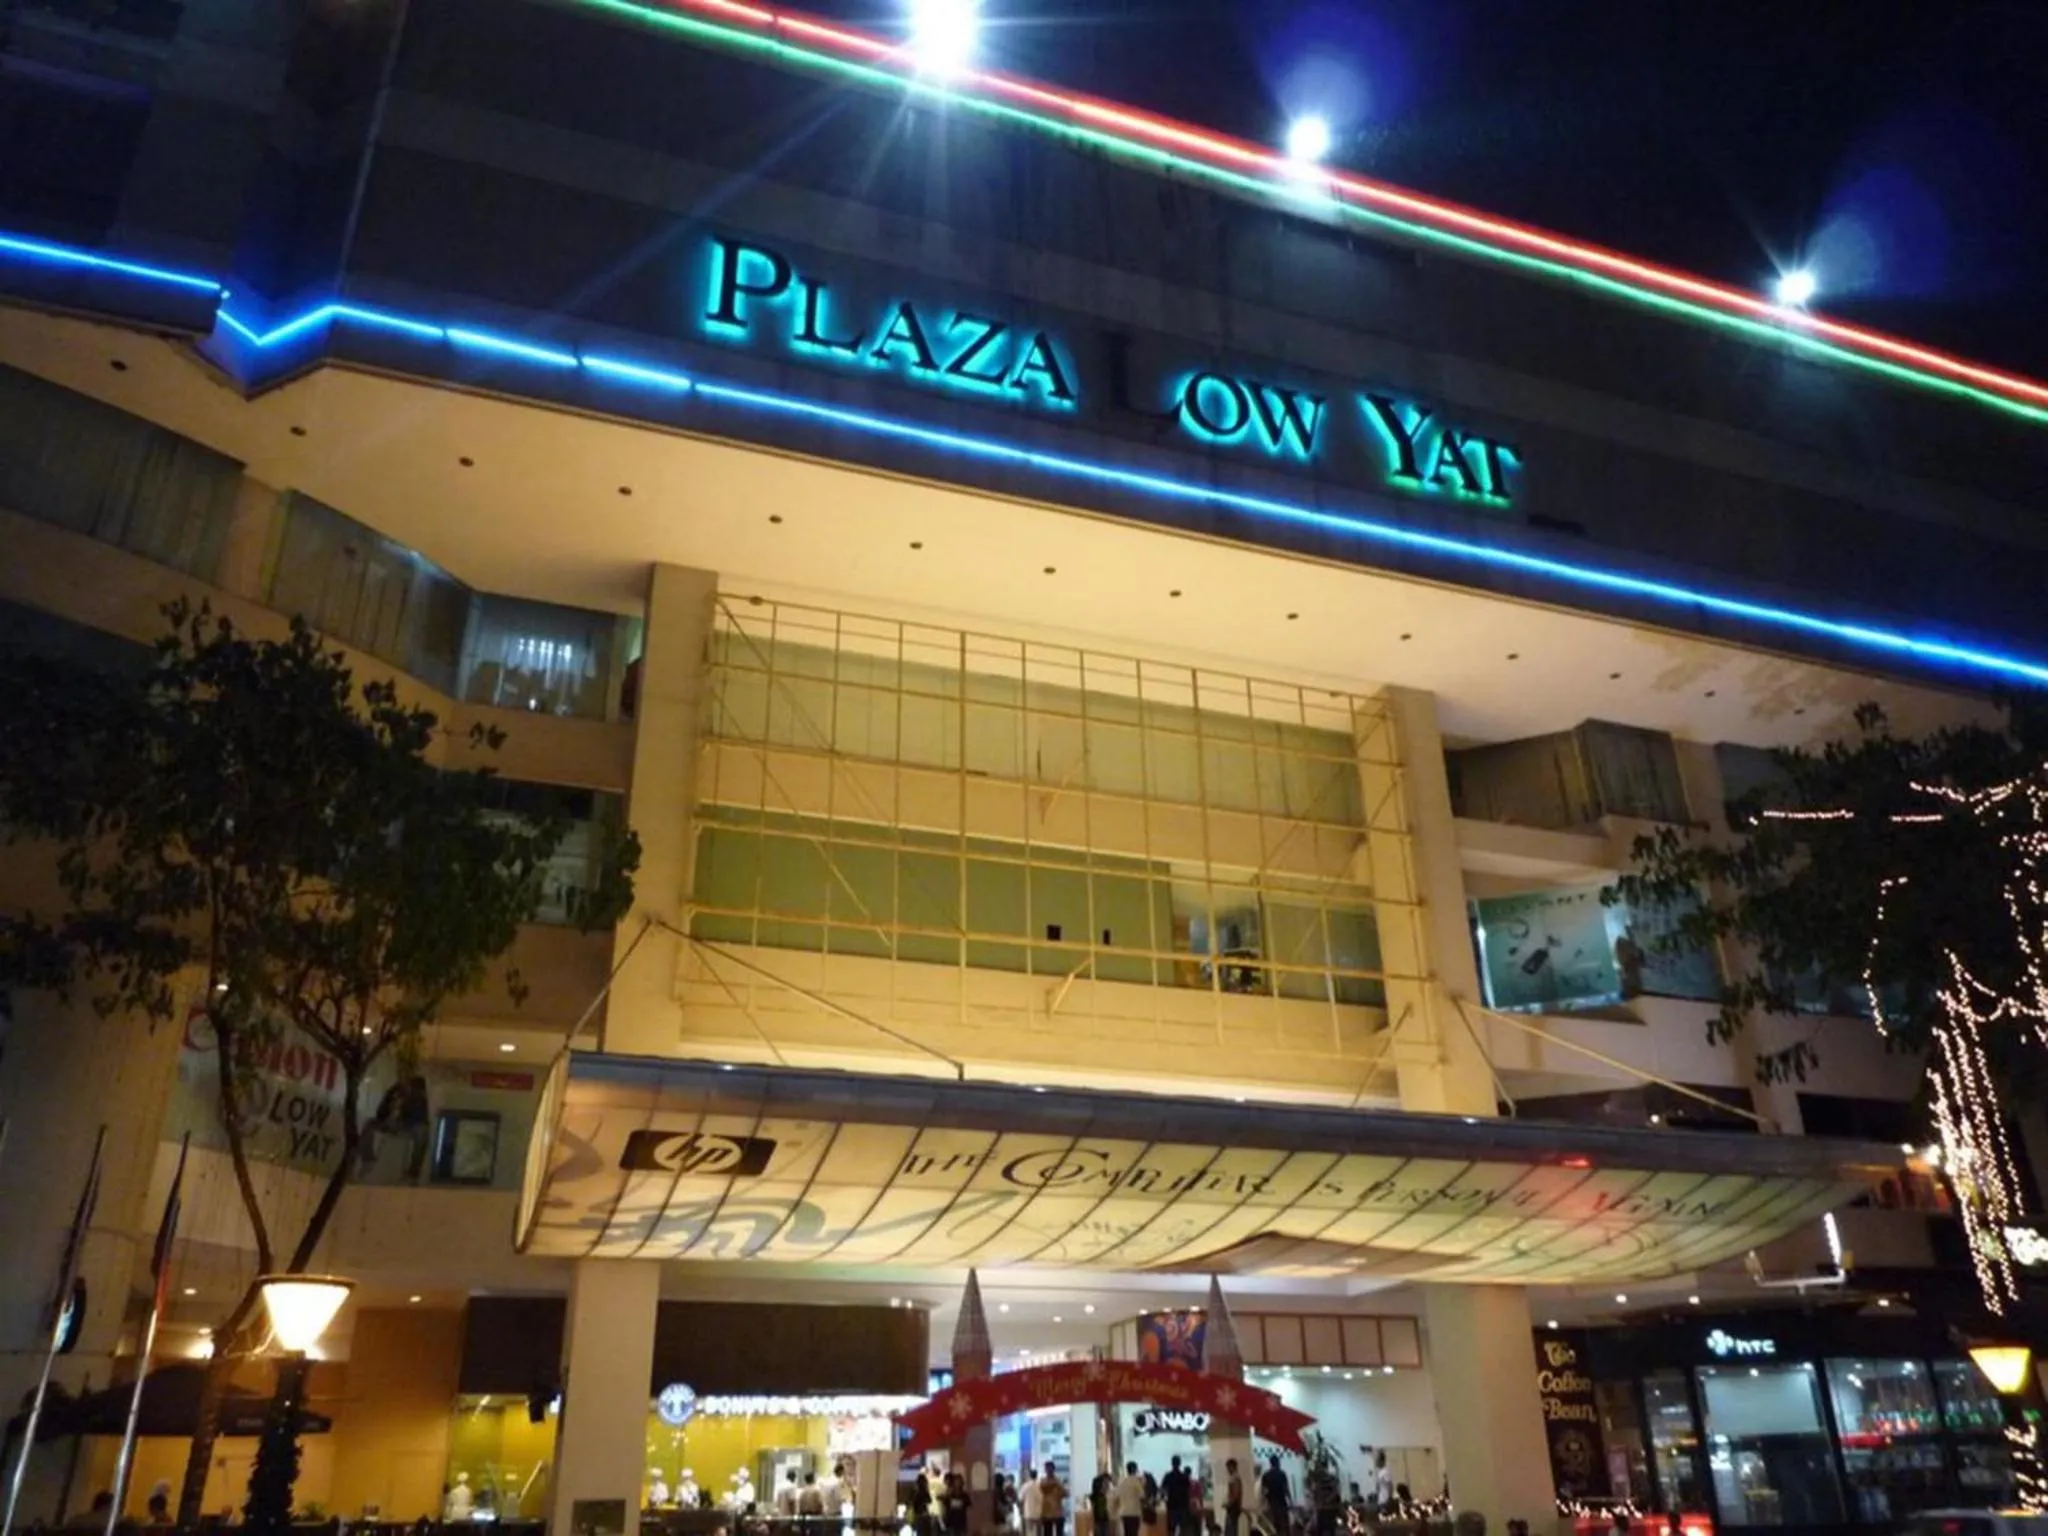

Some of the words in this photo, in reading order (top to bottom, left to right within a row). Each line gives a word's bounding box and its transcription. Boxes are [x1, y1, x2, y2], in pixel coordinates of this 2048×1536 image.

[706, 236, 1077, 408] PLAZA
[1360, 391, 1522, 505] YAT
[268, 1090, 331, 1130] LOW
[289, 1127, 335, 1163] YAT
[1536, 1370, 1593, 1394] Coffee
[1542, 1399, 1598, 1423] Bean
